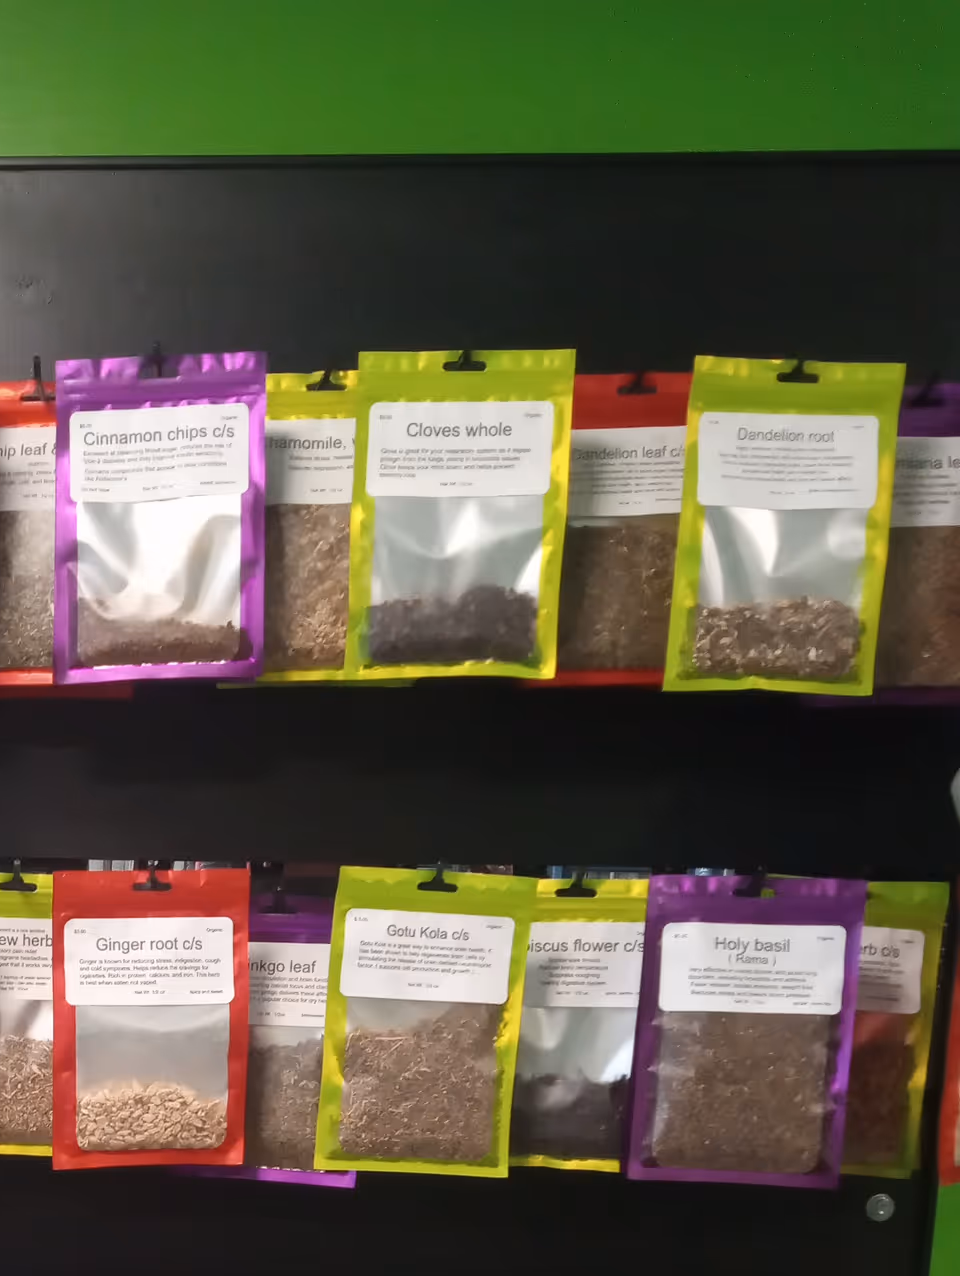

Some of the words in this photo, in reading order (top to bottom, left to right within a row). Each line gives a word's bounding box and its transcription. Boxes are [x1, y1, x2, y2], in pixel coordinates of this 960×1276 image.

[83, 429, 162, 446] Cinnamon
[167, 425, 208, 443] chips
[212, 423, 235, 438] c/s
[406, 421, 461, 438] Cloves
[466, 421, 513, 437] whole
[737, 427, 805, 442] Dandelion
[808, 429, 836, 443] root
[21, 442, 47, 457] leaf
[642, 445, 668, 459] leaf
[387, 924, 416, 939] Gotu
[419, 926, 448, 940] Kola
[451, 927, 470, 942] c/s
[96, 937, 146, 955] Ginger
[150, 936, 179, 951] root
[182, 936, 203, 951] c/s
[573, 938, 620, 953] flower
[623, 939, 644, 953] c/s
[715, 936, 750, 954] Holy
[753, 938, 790, 953] basil
[289, 959, 316, 974] leaf
[736, 954, 769, 965] Rama
